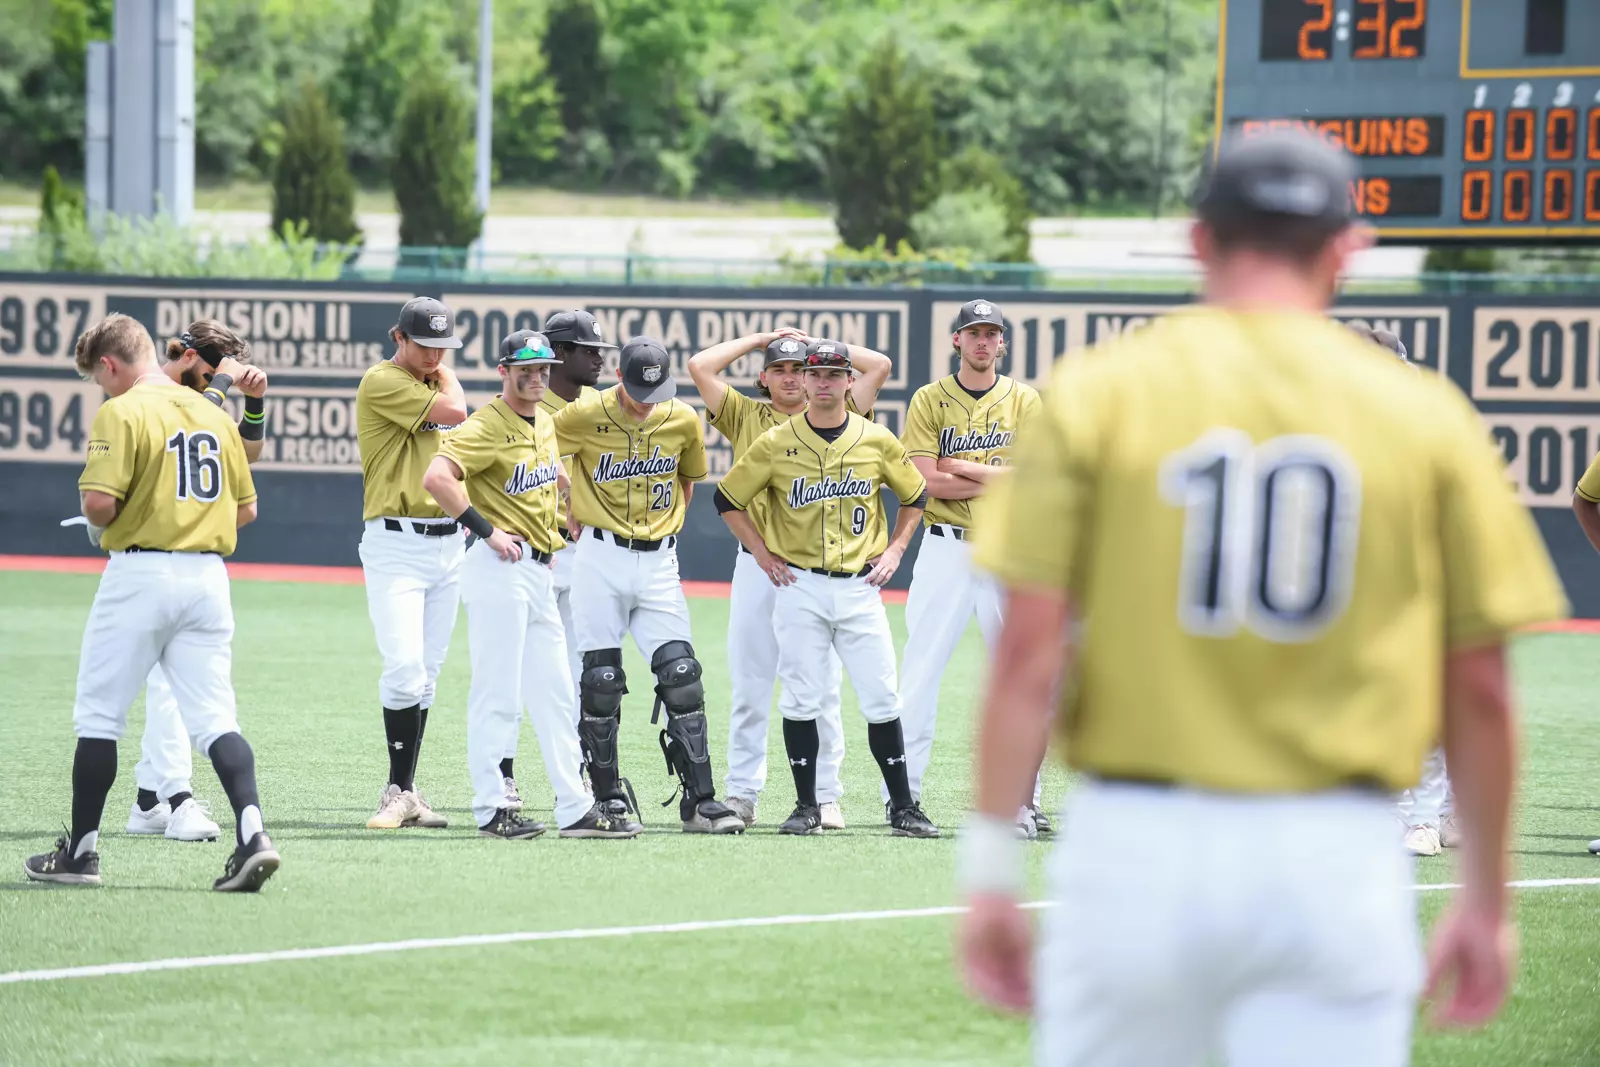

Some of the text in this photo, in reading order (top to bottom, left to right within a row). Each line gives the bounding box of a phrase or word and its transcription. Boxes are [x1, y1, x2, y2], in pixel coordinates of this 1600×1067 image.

[1474, 84, 1488, 108] 1
[1512, 82, 1533, 108] 2
[1553, 81, 1574, 107] 3
[1243, 118, 1430, 155] GUINS
[593, 308, 692, 349] NCAA
[308, 342, 384, 369] SERIES
[1487, 319, 1600, 389] 201
[167, 428, 223, 503] 16
[594, 445, 679, 483] Mastodons
[1491, 426, 1600, 496] 201
[650, 480, 673, 512] 26
[788, 467, 873, 510] Mastodons
[851, 505, 867, 537] 9
[1157, 425, 1363, 644] 10
